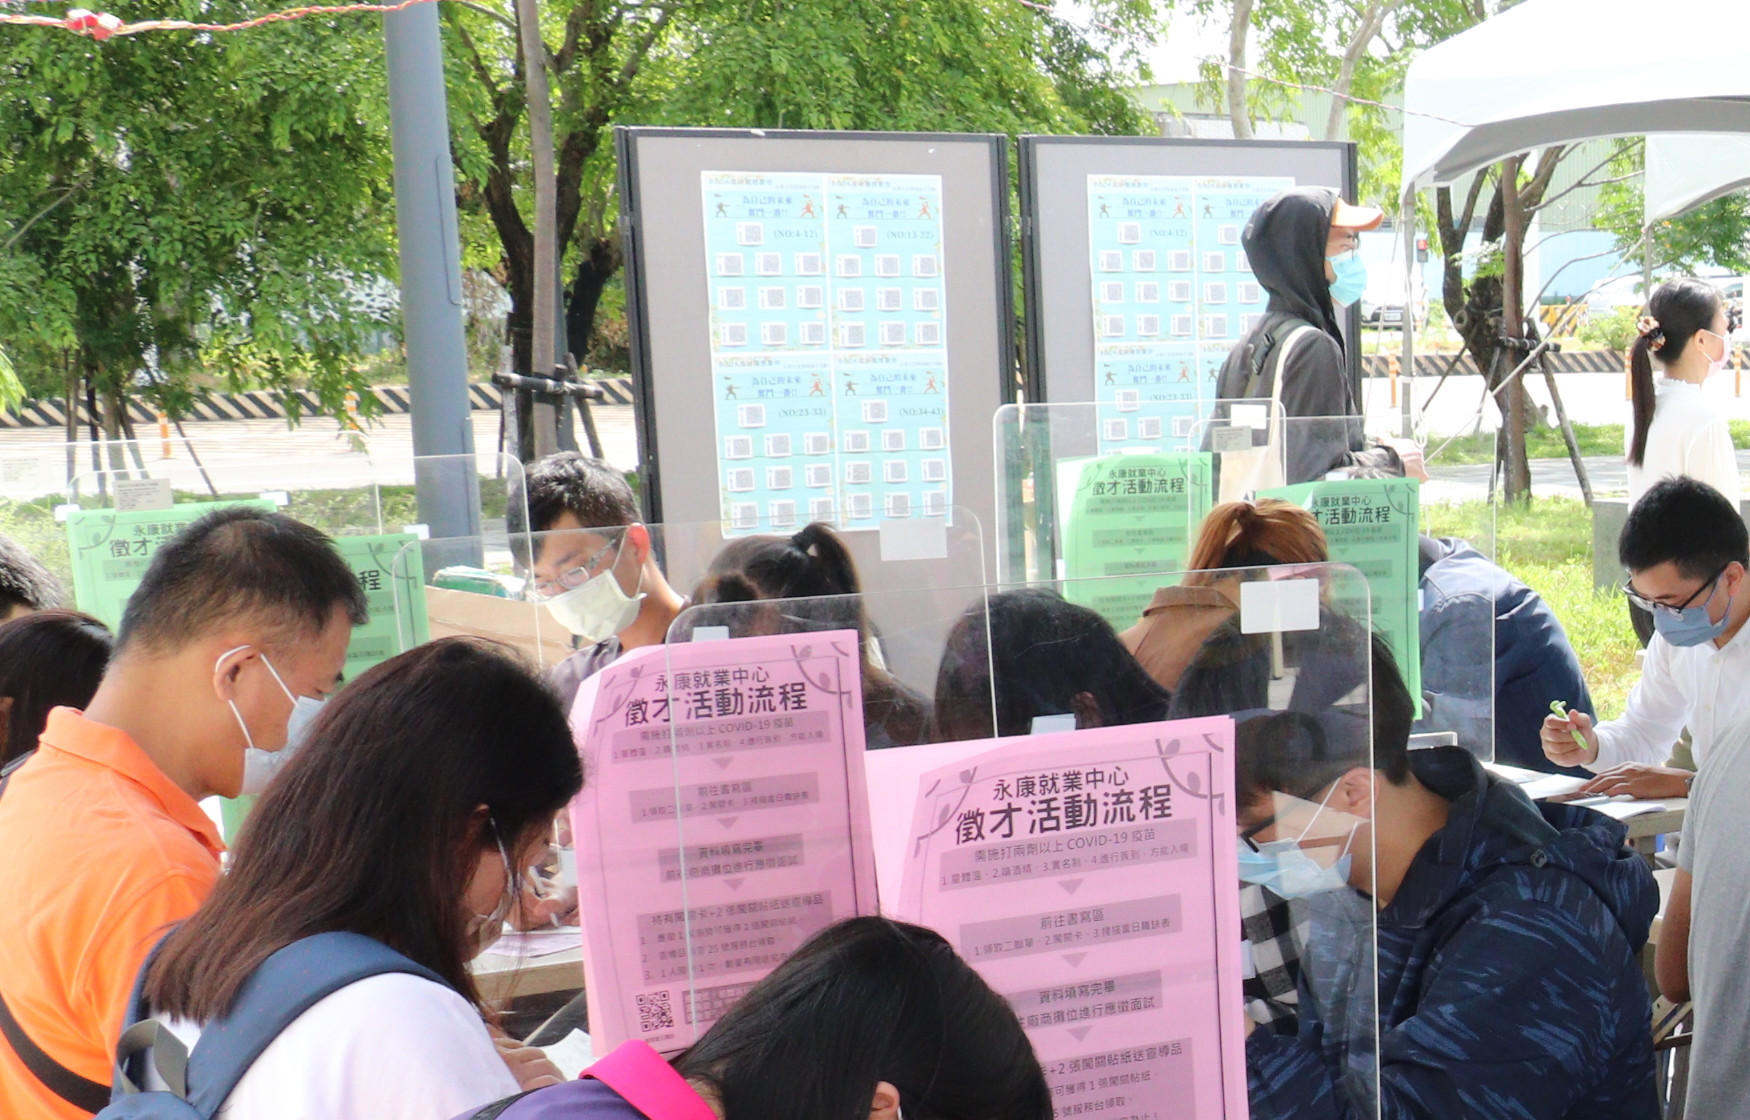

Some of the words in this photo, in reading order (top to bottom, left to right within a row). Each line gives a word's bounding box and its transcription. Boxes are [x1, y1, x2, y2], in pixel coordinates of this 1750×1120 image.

[1108, 468, 1167, 479] 永康就業中心
[1093, 477, 1185, 496] 徵才活動流程
[655, 665, 770, 693] 永康就業中心
[624, 681, 808, 727] 徵才活動流程
[718, 719, 770, 735] COVID-19
[992, 765, 1129, 802] 永康就業中心
[954, 783, 1173, 845] 徵才活動流程
[1066, 832, 1128, 851] COVID-19
[1131, 828, 1155, 842] 疫苗
[1040, 908, 1105, 930] 前往書寫區
